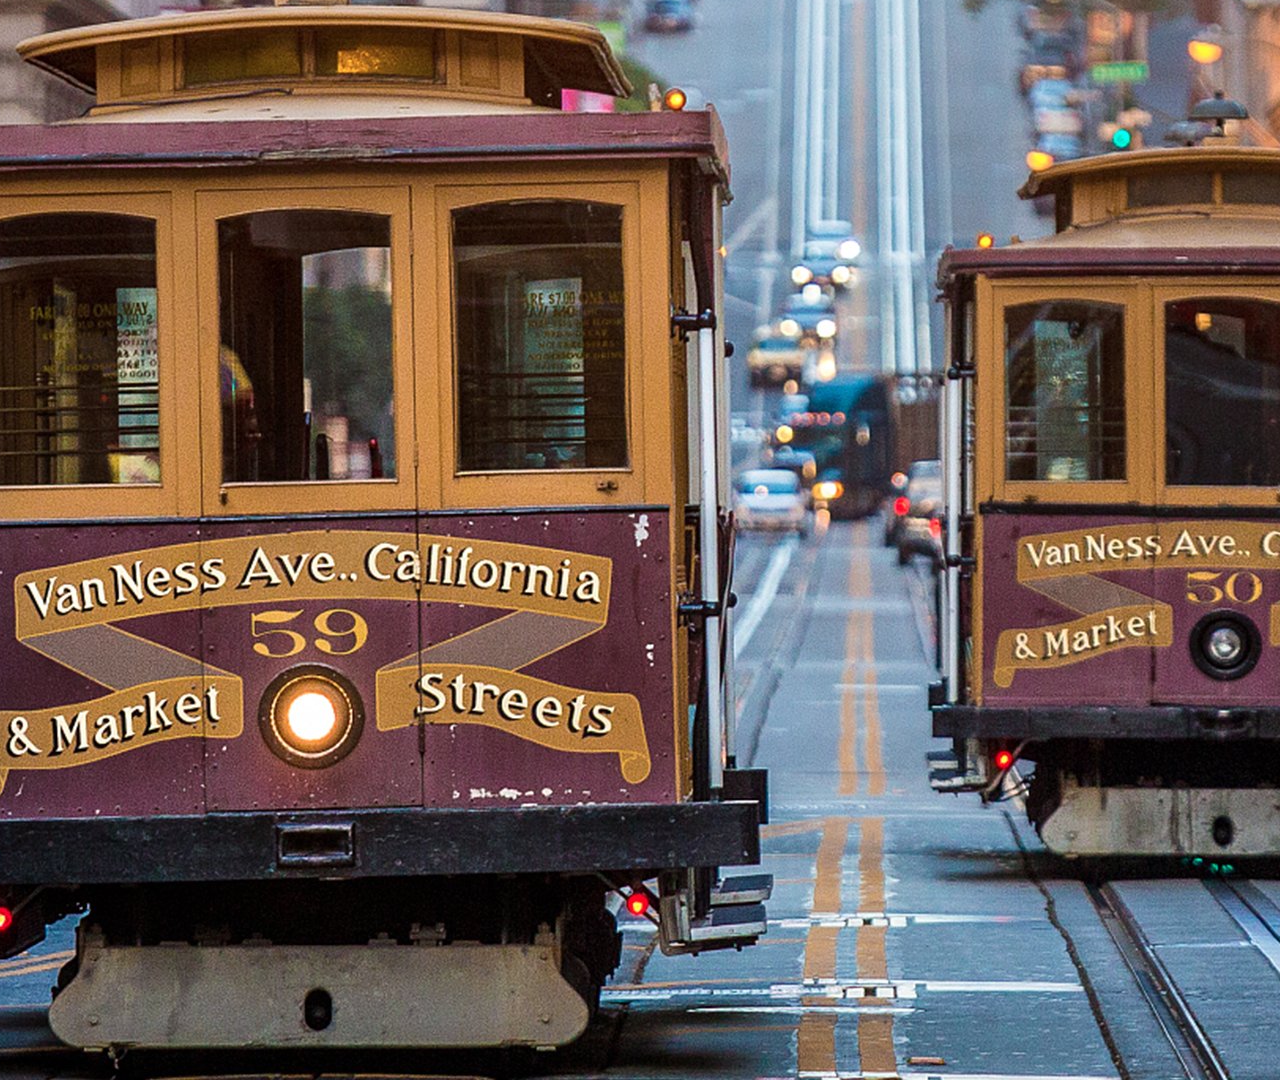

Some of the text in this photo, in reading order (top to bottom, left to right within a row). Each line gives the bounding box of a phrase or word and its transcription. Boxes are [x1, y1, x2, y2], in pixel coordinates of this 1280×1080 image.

[123, 301, 149, 316] WAY
[366, 542, 604, 605] California
[1186, 571, 1263, 604] 50
[249, 608, 369, 658] 59
[1014, 631, 1034, 660] &
[1043, 609, 1158, 656] Market
[5, 671, 616, 756] & Market Streets
